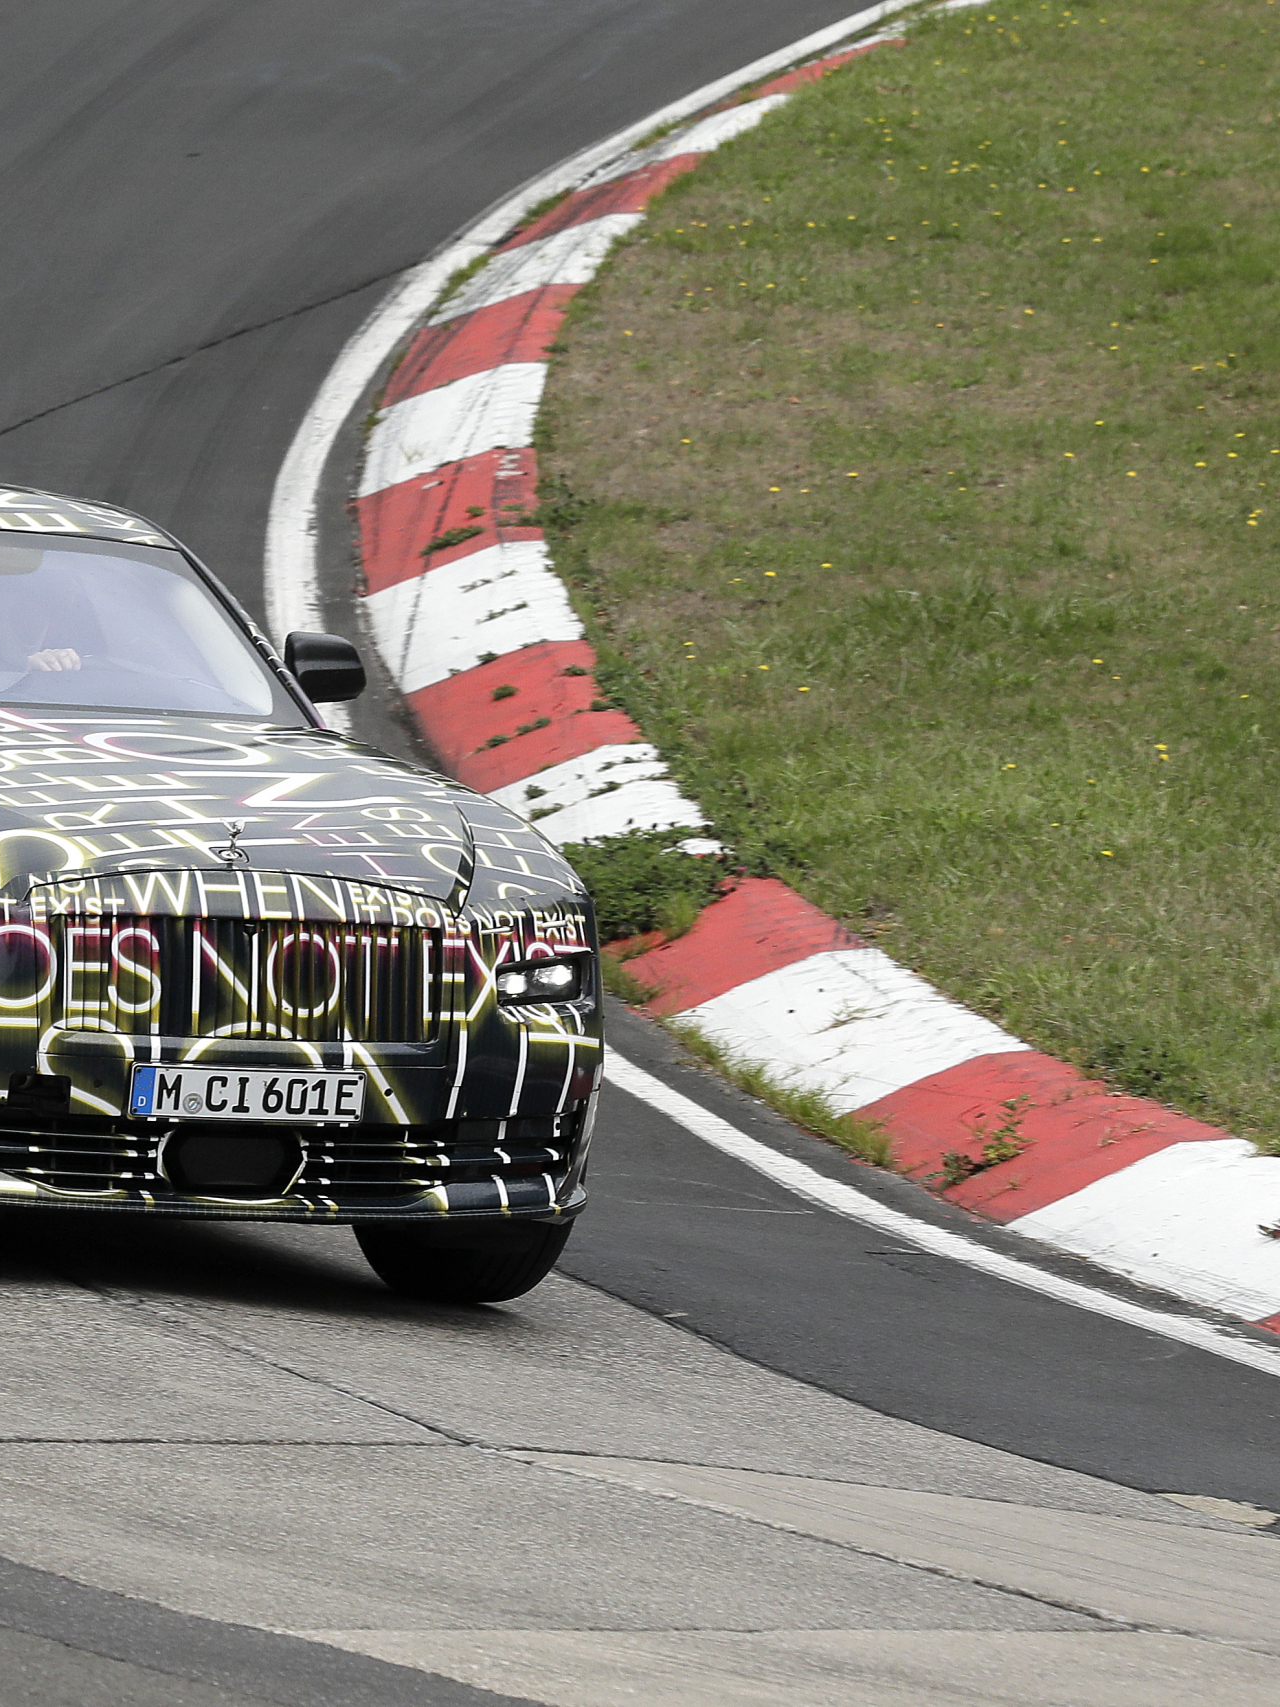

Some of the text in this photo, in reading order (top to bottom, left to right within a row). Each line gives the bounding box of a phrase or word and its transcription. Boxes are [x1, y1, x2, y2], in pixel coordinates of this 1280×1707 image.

[30, 896, 126, 924] EXIST
[118, 865, 347, 923] WHEN
[390, 906, 472, 935] DOES
[474, 908, 526, 937] NOT
[532, 911, 586, 942] EXIST
[192, 926, 399, 1020] NOT
[138, 1096, 147, 1107] D
[157, 1073, 359, 1116] M CI 601E
